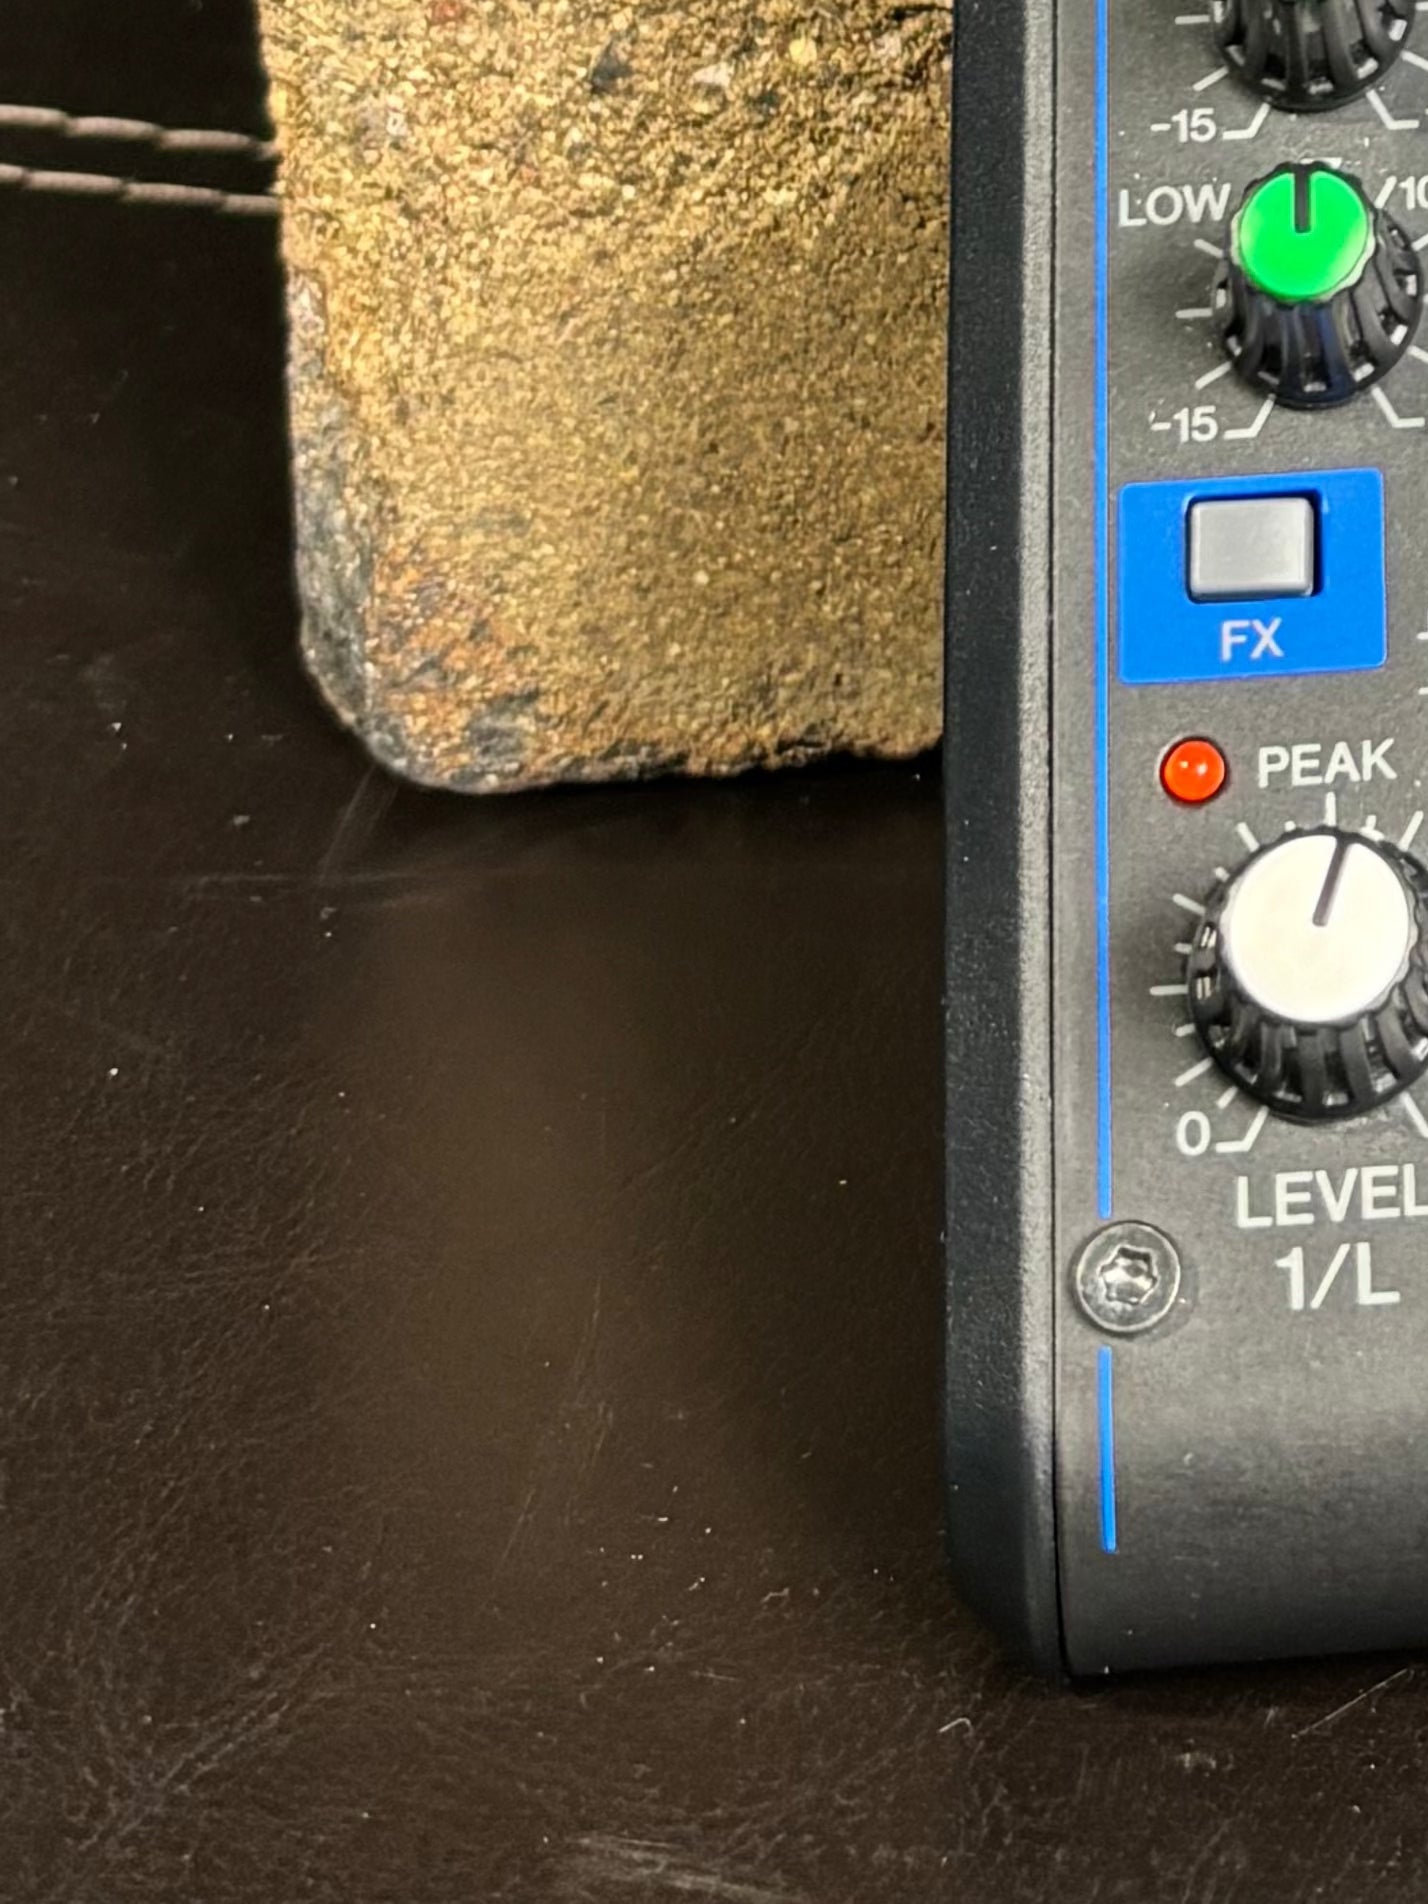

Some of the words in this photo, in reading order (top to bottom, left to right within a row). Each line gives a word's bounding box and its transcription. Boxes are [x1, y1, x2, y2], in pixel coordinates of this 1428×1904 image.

[1150, 107, 1217, 143] -15
[1118, 182, 1232, 228] LOW
[1148, 405, 1219, 444] -15
[1221, 617, 1284, 662] FX
[1257, 737, 1398, 789] PEAK
[1175, 1110, 1211, 1157] 0
[1274, 1241, 1401, 1311] 1/L
